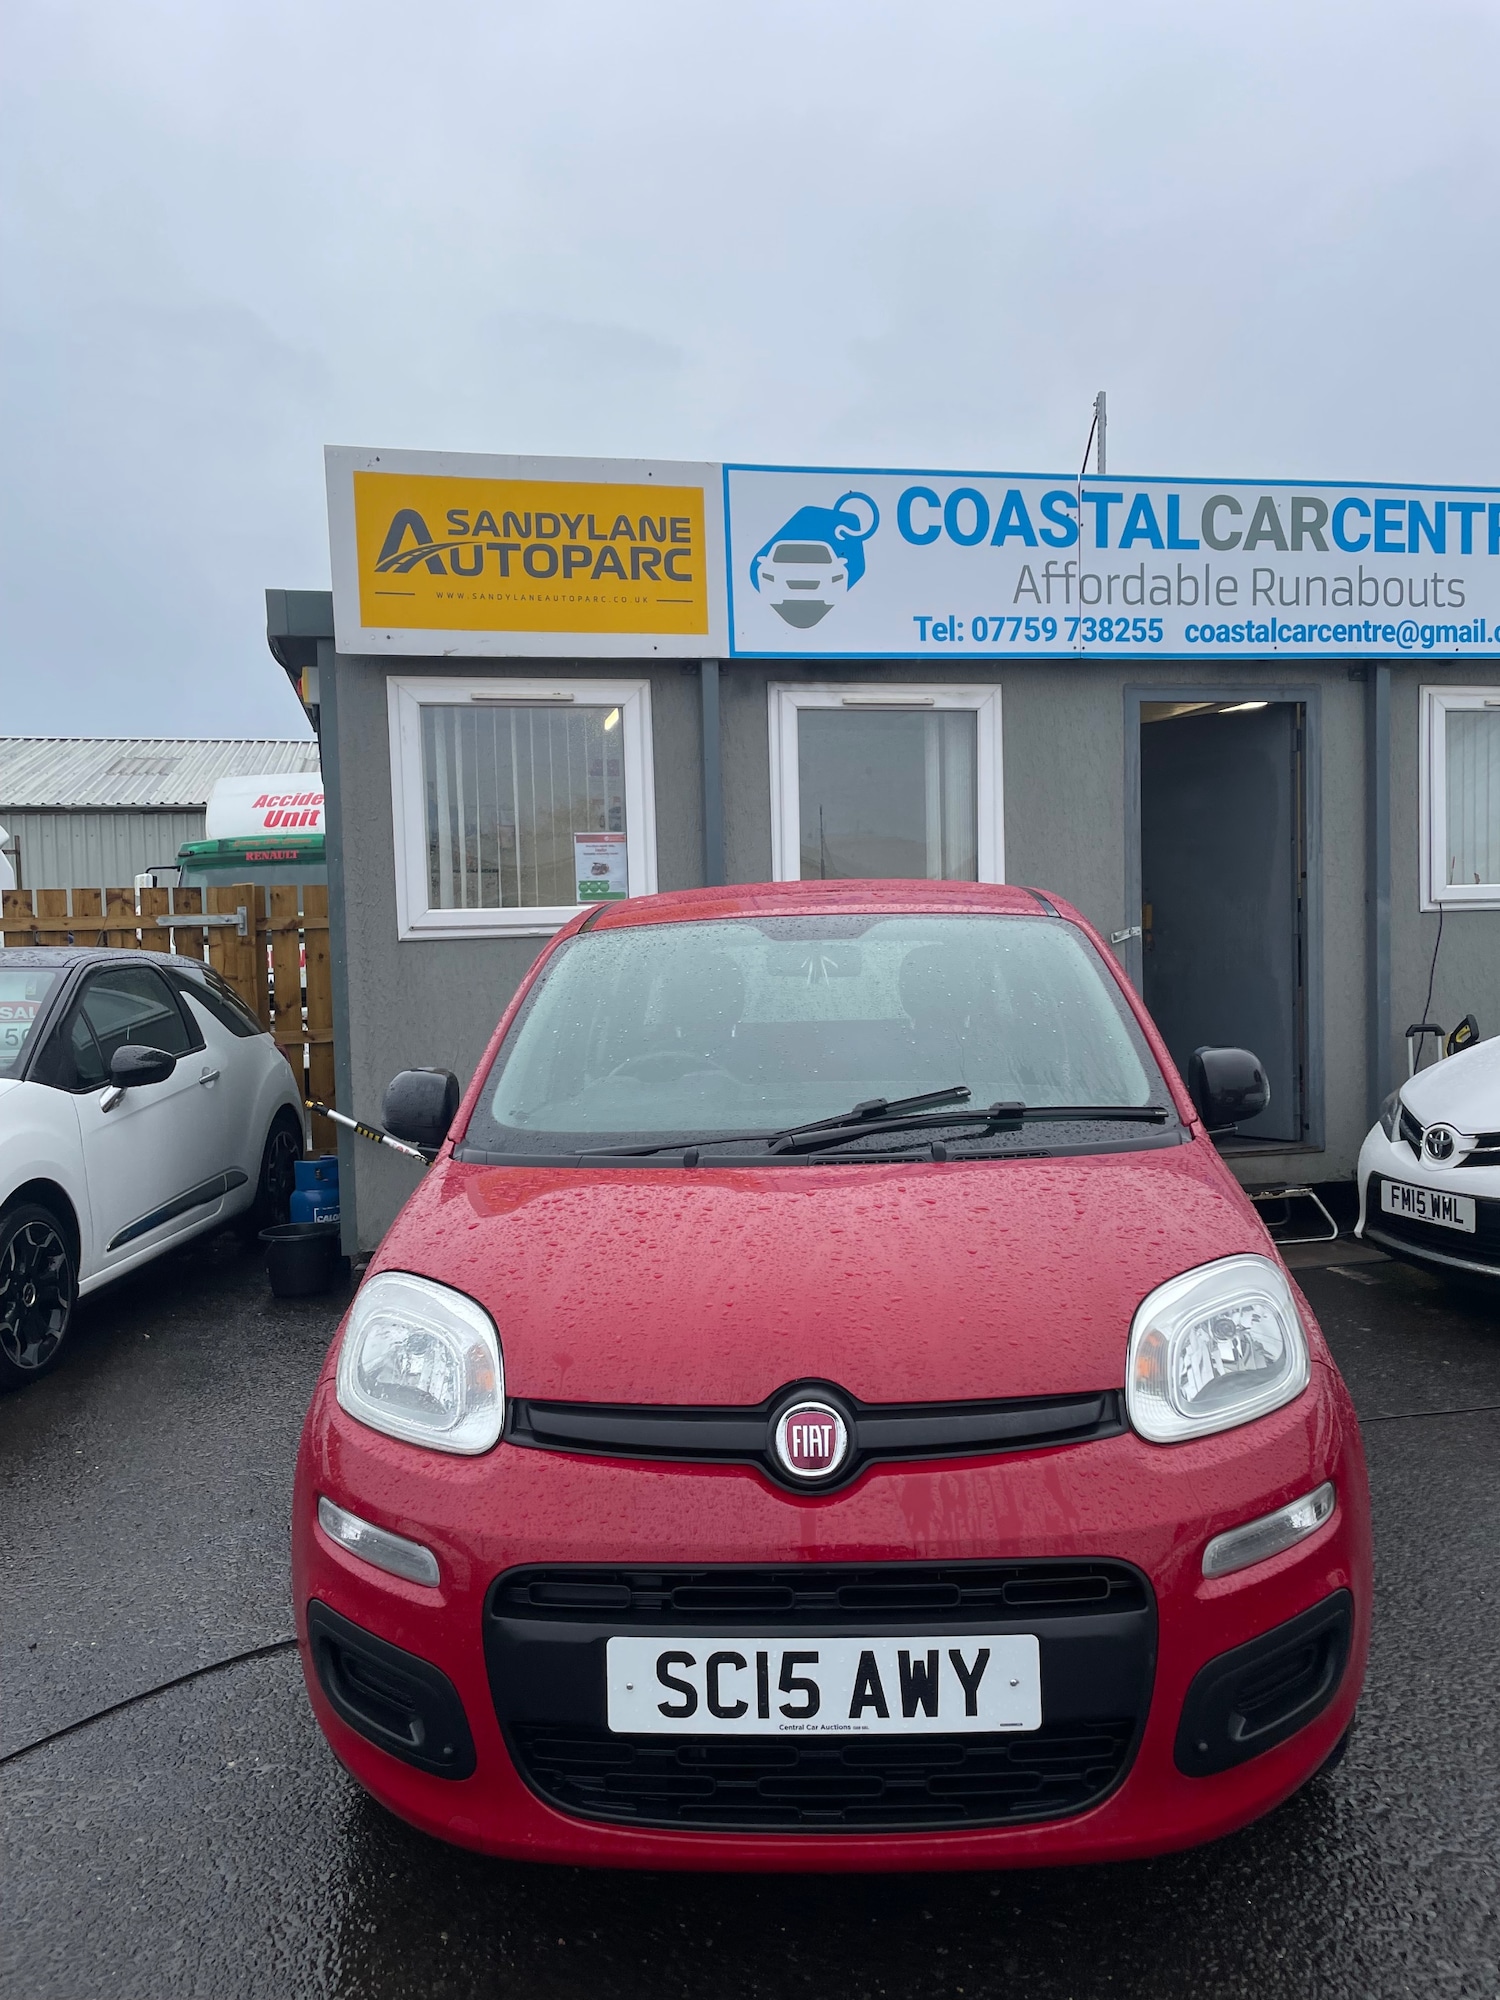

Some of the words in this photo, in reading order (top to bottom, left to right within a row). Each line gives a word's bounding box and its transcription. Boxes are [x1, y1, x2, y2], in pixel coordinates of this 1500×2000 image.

[446, 509, 692, 543] SANDYLANE
[374, 508, 693, 582] AUTOPARC
[436, 591, 649, 604] WWW.SANDYLANEAUTOPARC.CO.UK
[1012, 561, 1239, 606] Affordable
[1251, 564, 1466, 608] Runabouts
[913, 615, 964, 642] Tel:
[971, 616, 1058, 642] 07759
[1064, 616, 1164, 643] 738255
[263, 809, 320, 828] Unit
[245, 850, 299, 861] RENAULT
[1391, 1185, 1426, 1215] FM15
[1431, 1193, 1464, 1224] WML
[792, 1425, 833, 1458] FIAT
[656, 1651, 820, 1719] SC15
[848, 1648, 990, 1719] AWY
